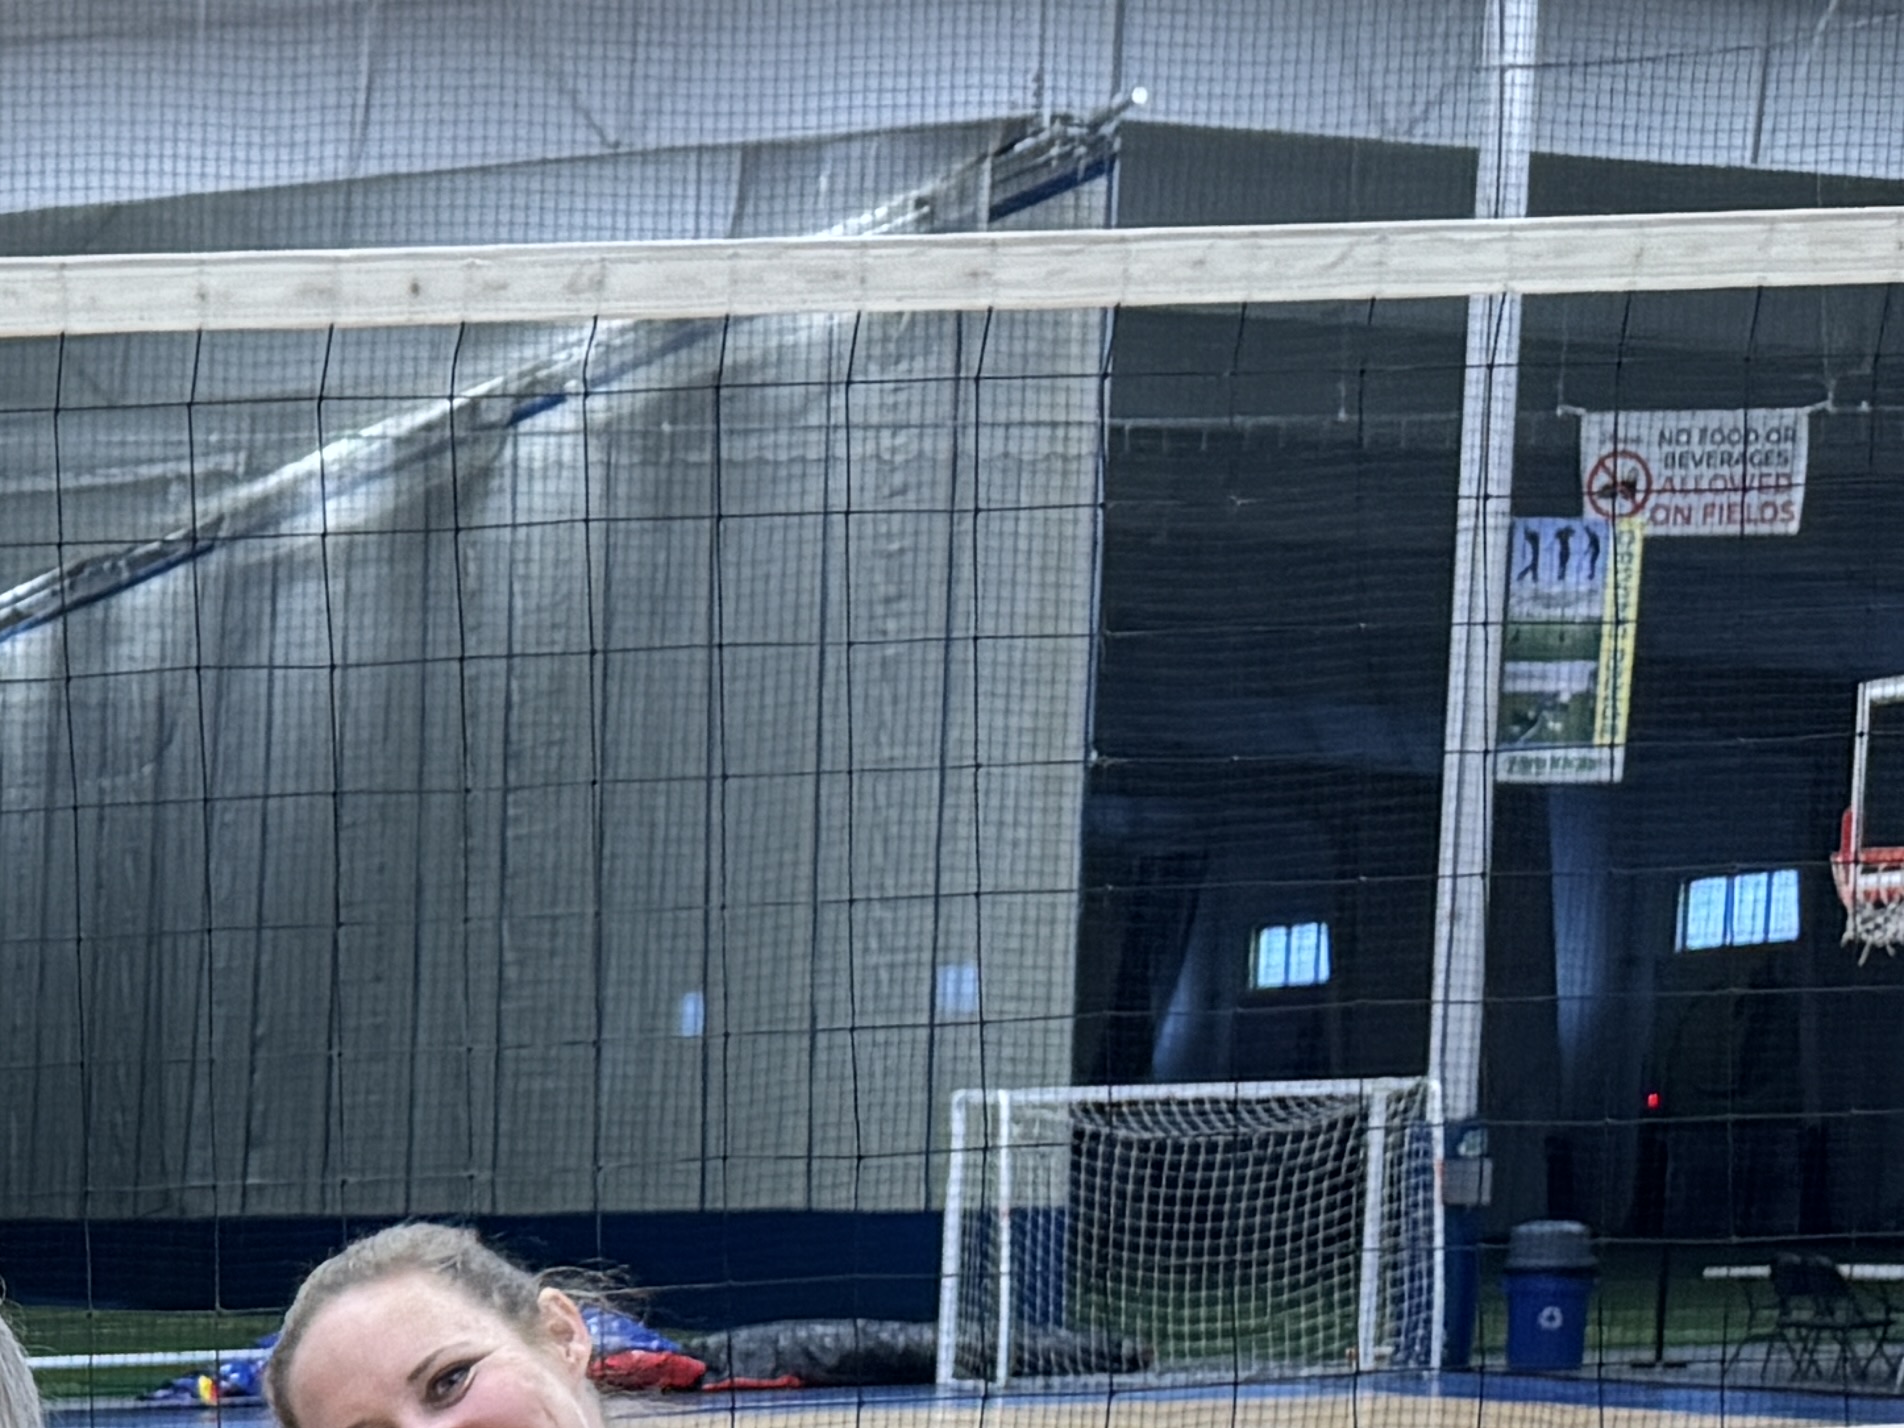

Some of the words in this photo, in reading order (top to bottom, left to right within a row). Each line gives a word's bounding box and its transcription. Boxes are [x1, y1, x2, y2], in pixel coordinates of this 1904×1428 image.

[1658, 427, 1691, 447] NO
[1765, 425, 1797, 445] OR
[1663, 448, 1789, 468] BEVERAGES
[1661, 471, 1792, 494] ALLOWED
[1650, 502, 1691, 525] ON
[1702, 501, 1796, 525] FIELDS
